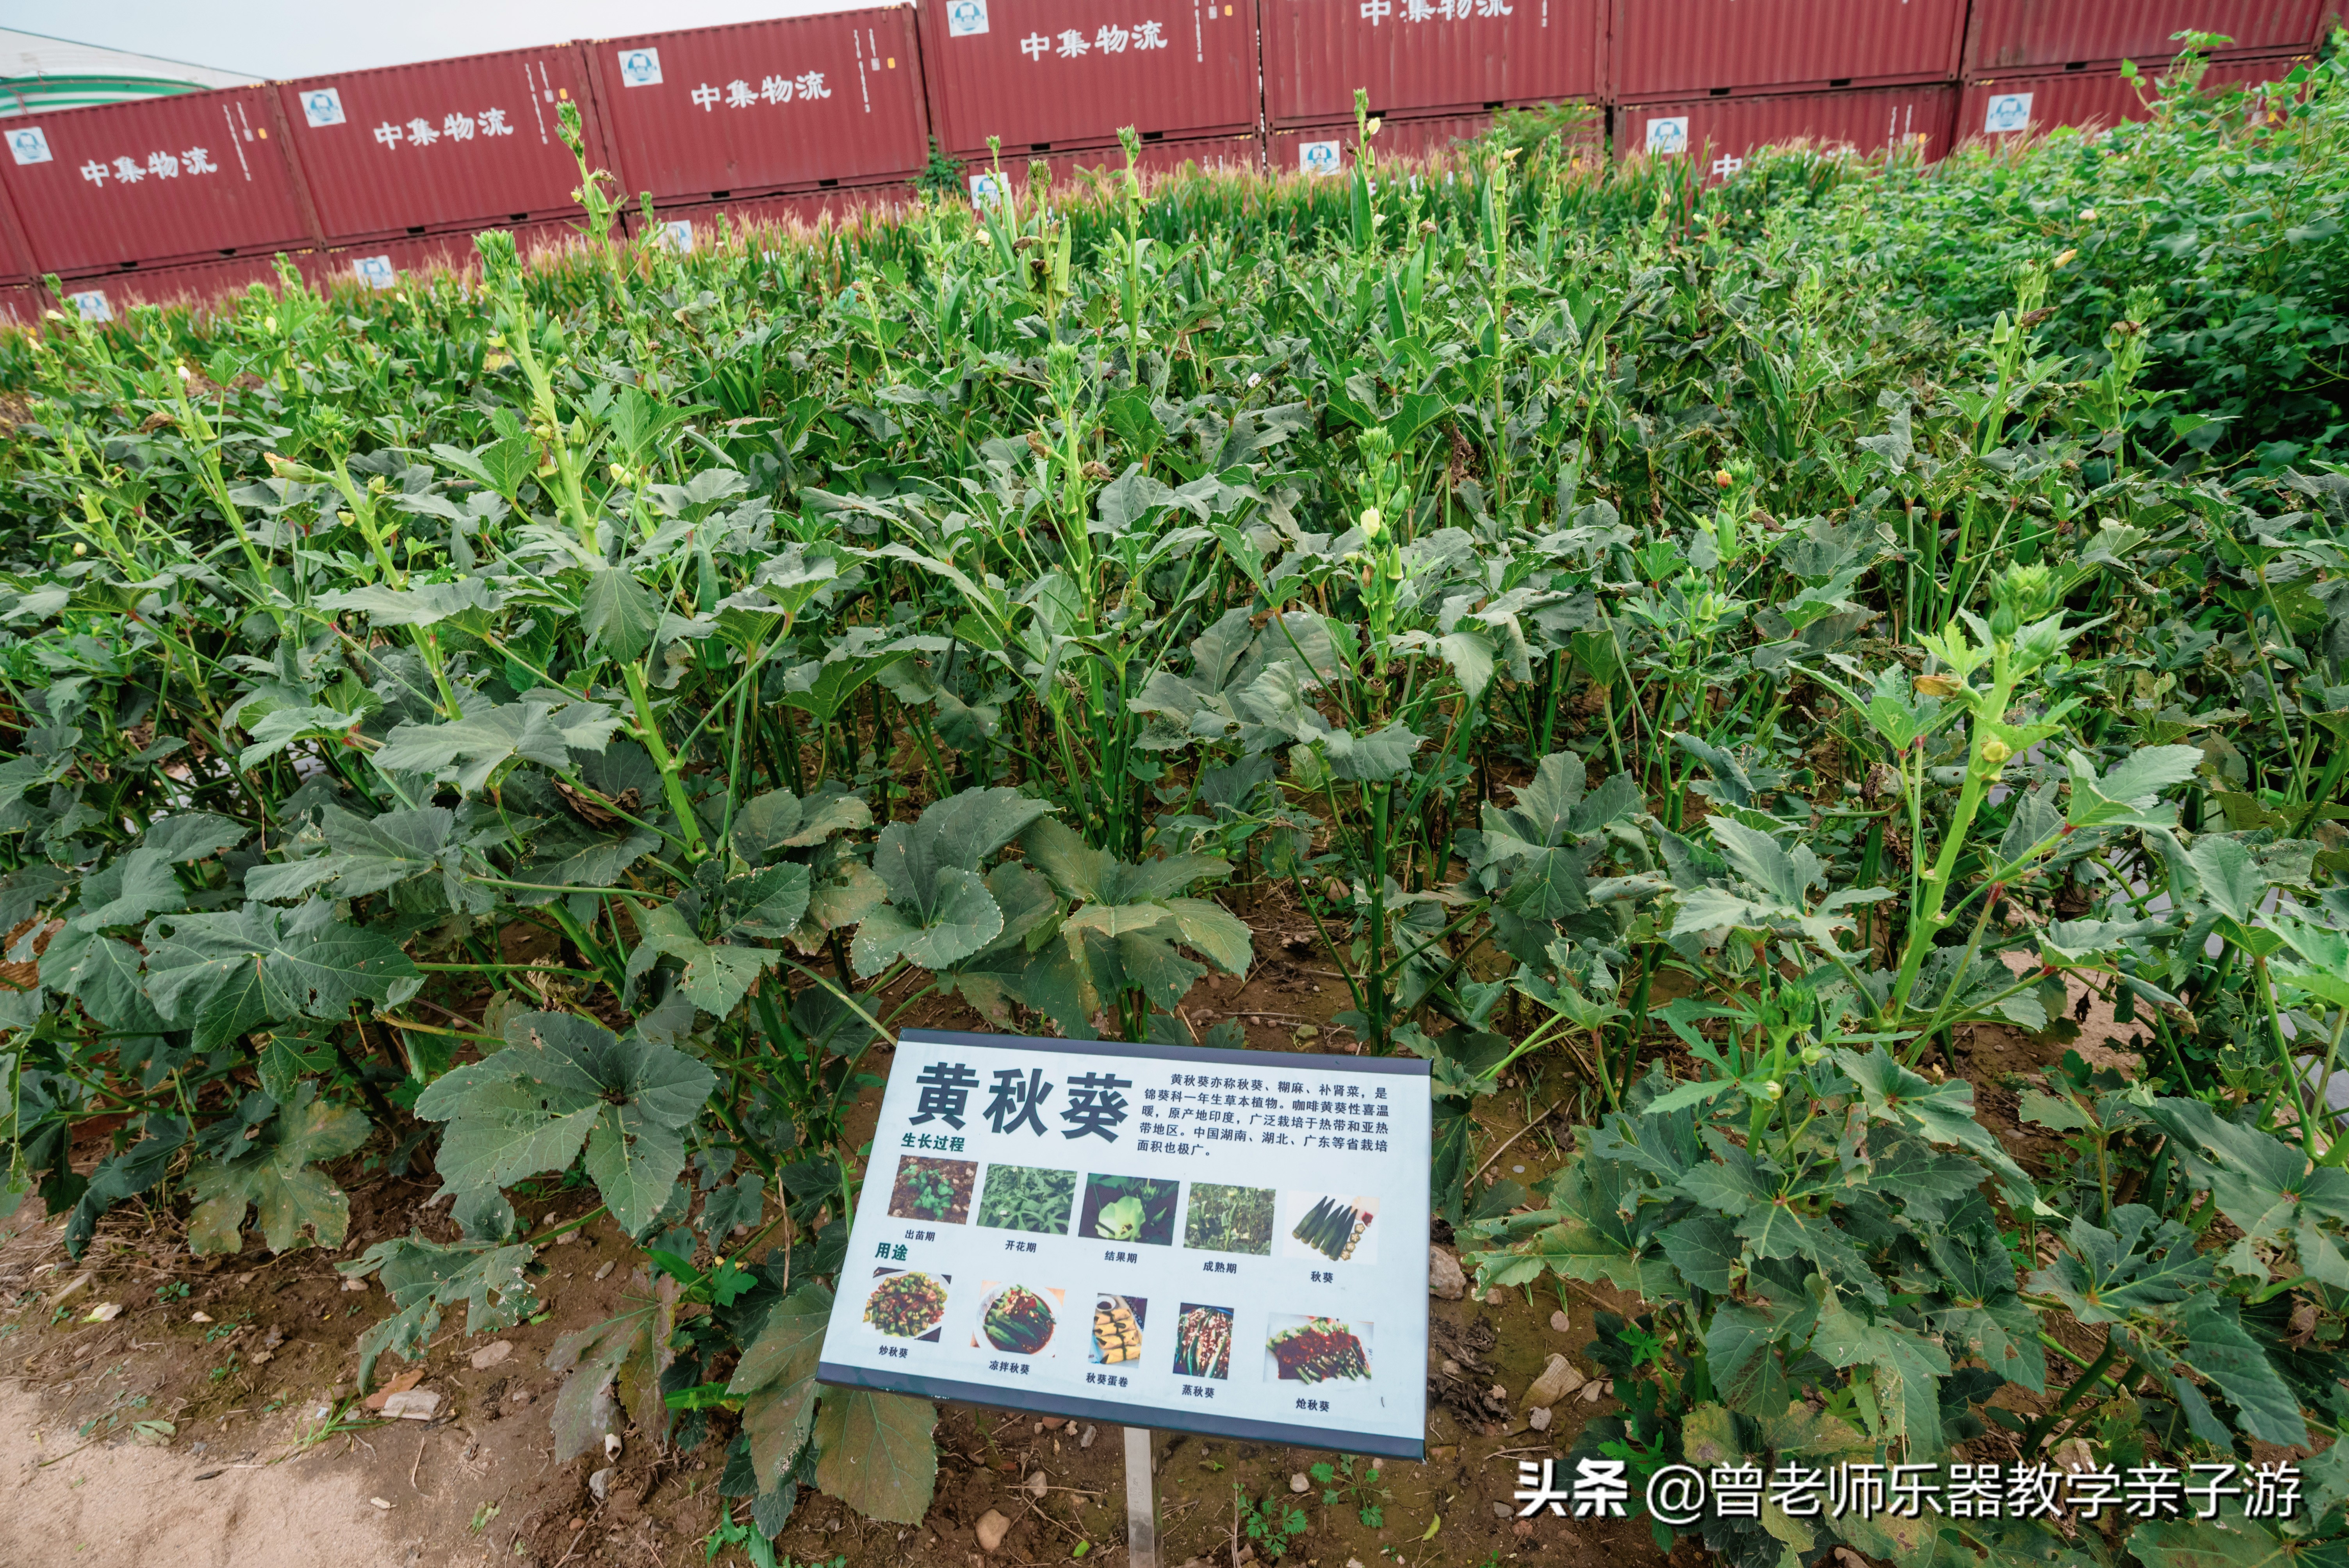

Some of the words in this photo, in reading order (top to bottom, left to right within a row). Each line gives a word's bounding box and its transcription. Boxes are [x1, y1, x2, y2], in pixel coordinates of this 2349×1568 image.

[1020, 20, 1168, 61] 中集物流
[691, 71, 831, 112] 中集物流
[374, 107, 513, 150] 中集物流
[80, 146, 217, 187] 中集物流
[909, 1062, 1132, 1143] 黄秋葵
[1144, 1089, 1389, 1117] 锦葵科一年生草本植物。咖啡黄葵性喜温
[901, 1133, 965, 1152] 生长过程
[1137, 1140, 1209, 1156] 面积也极广。
[905, 1229, 936, 1242] 出苗期
[875, 1242, 908, 1261] 用途
[1005, 1240, 1037, 1253] 开花期
[1104, 1251, 1137, 1264] 结果期
[1203, 1261, 1237, 1274] 成熟期
[1310, 1271, 1333, 1283] 秋葵
[879, 1345, 908, 1358] 炒秋葵
[989, 1360, 1030, 1375] 凉拌秋葵
[1086, 1372, 1128, 1387] 秋葵蛋卷
[1182, 1384, 1215, 1399] 蒸秋葵
